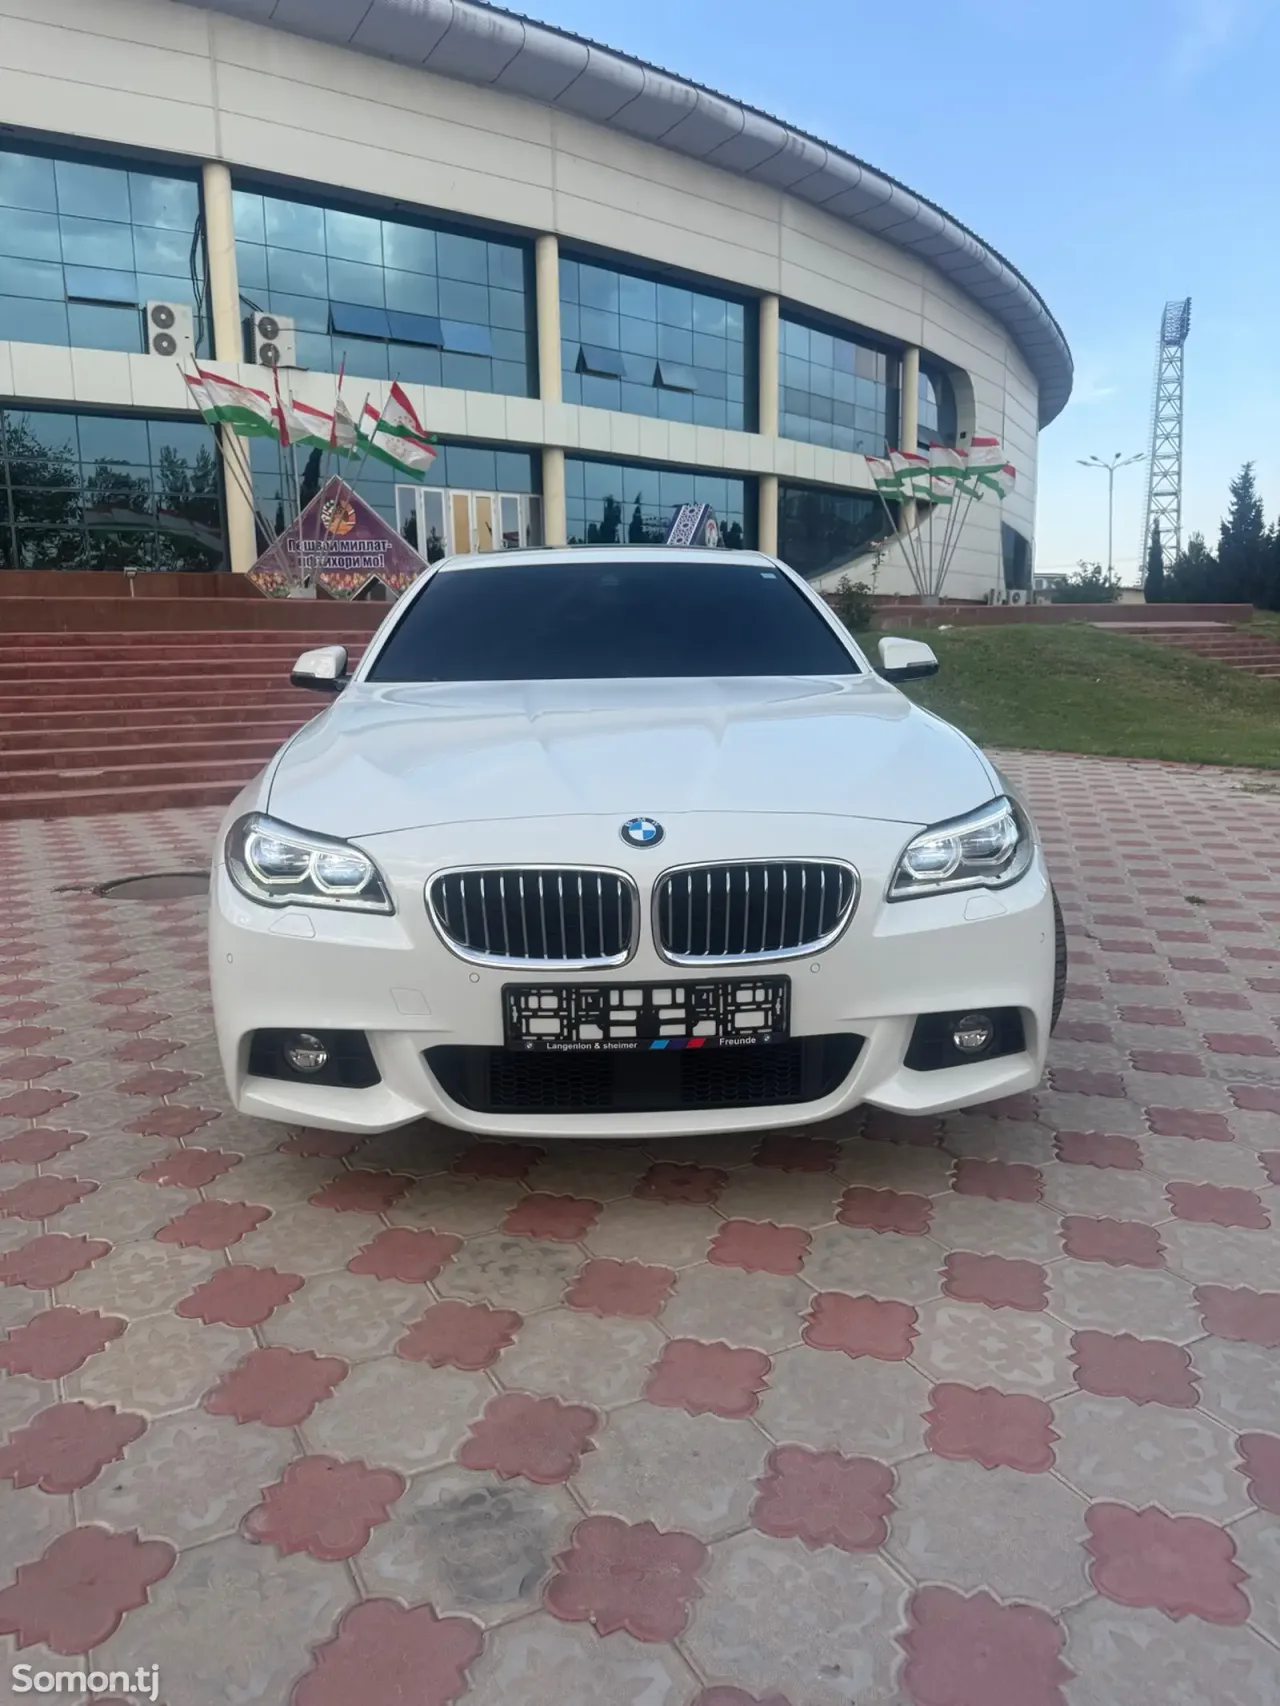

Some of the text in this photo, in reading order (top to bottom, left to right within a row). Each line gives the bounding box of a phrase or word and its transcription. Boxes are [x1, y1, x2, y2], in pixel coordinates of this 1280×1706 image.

[361, 553, 385, 568] мо!
[593, 1042, 601, 1050] &
[719, 1036, 757, 1046] Freunde
